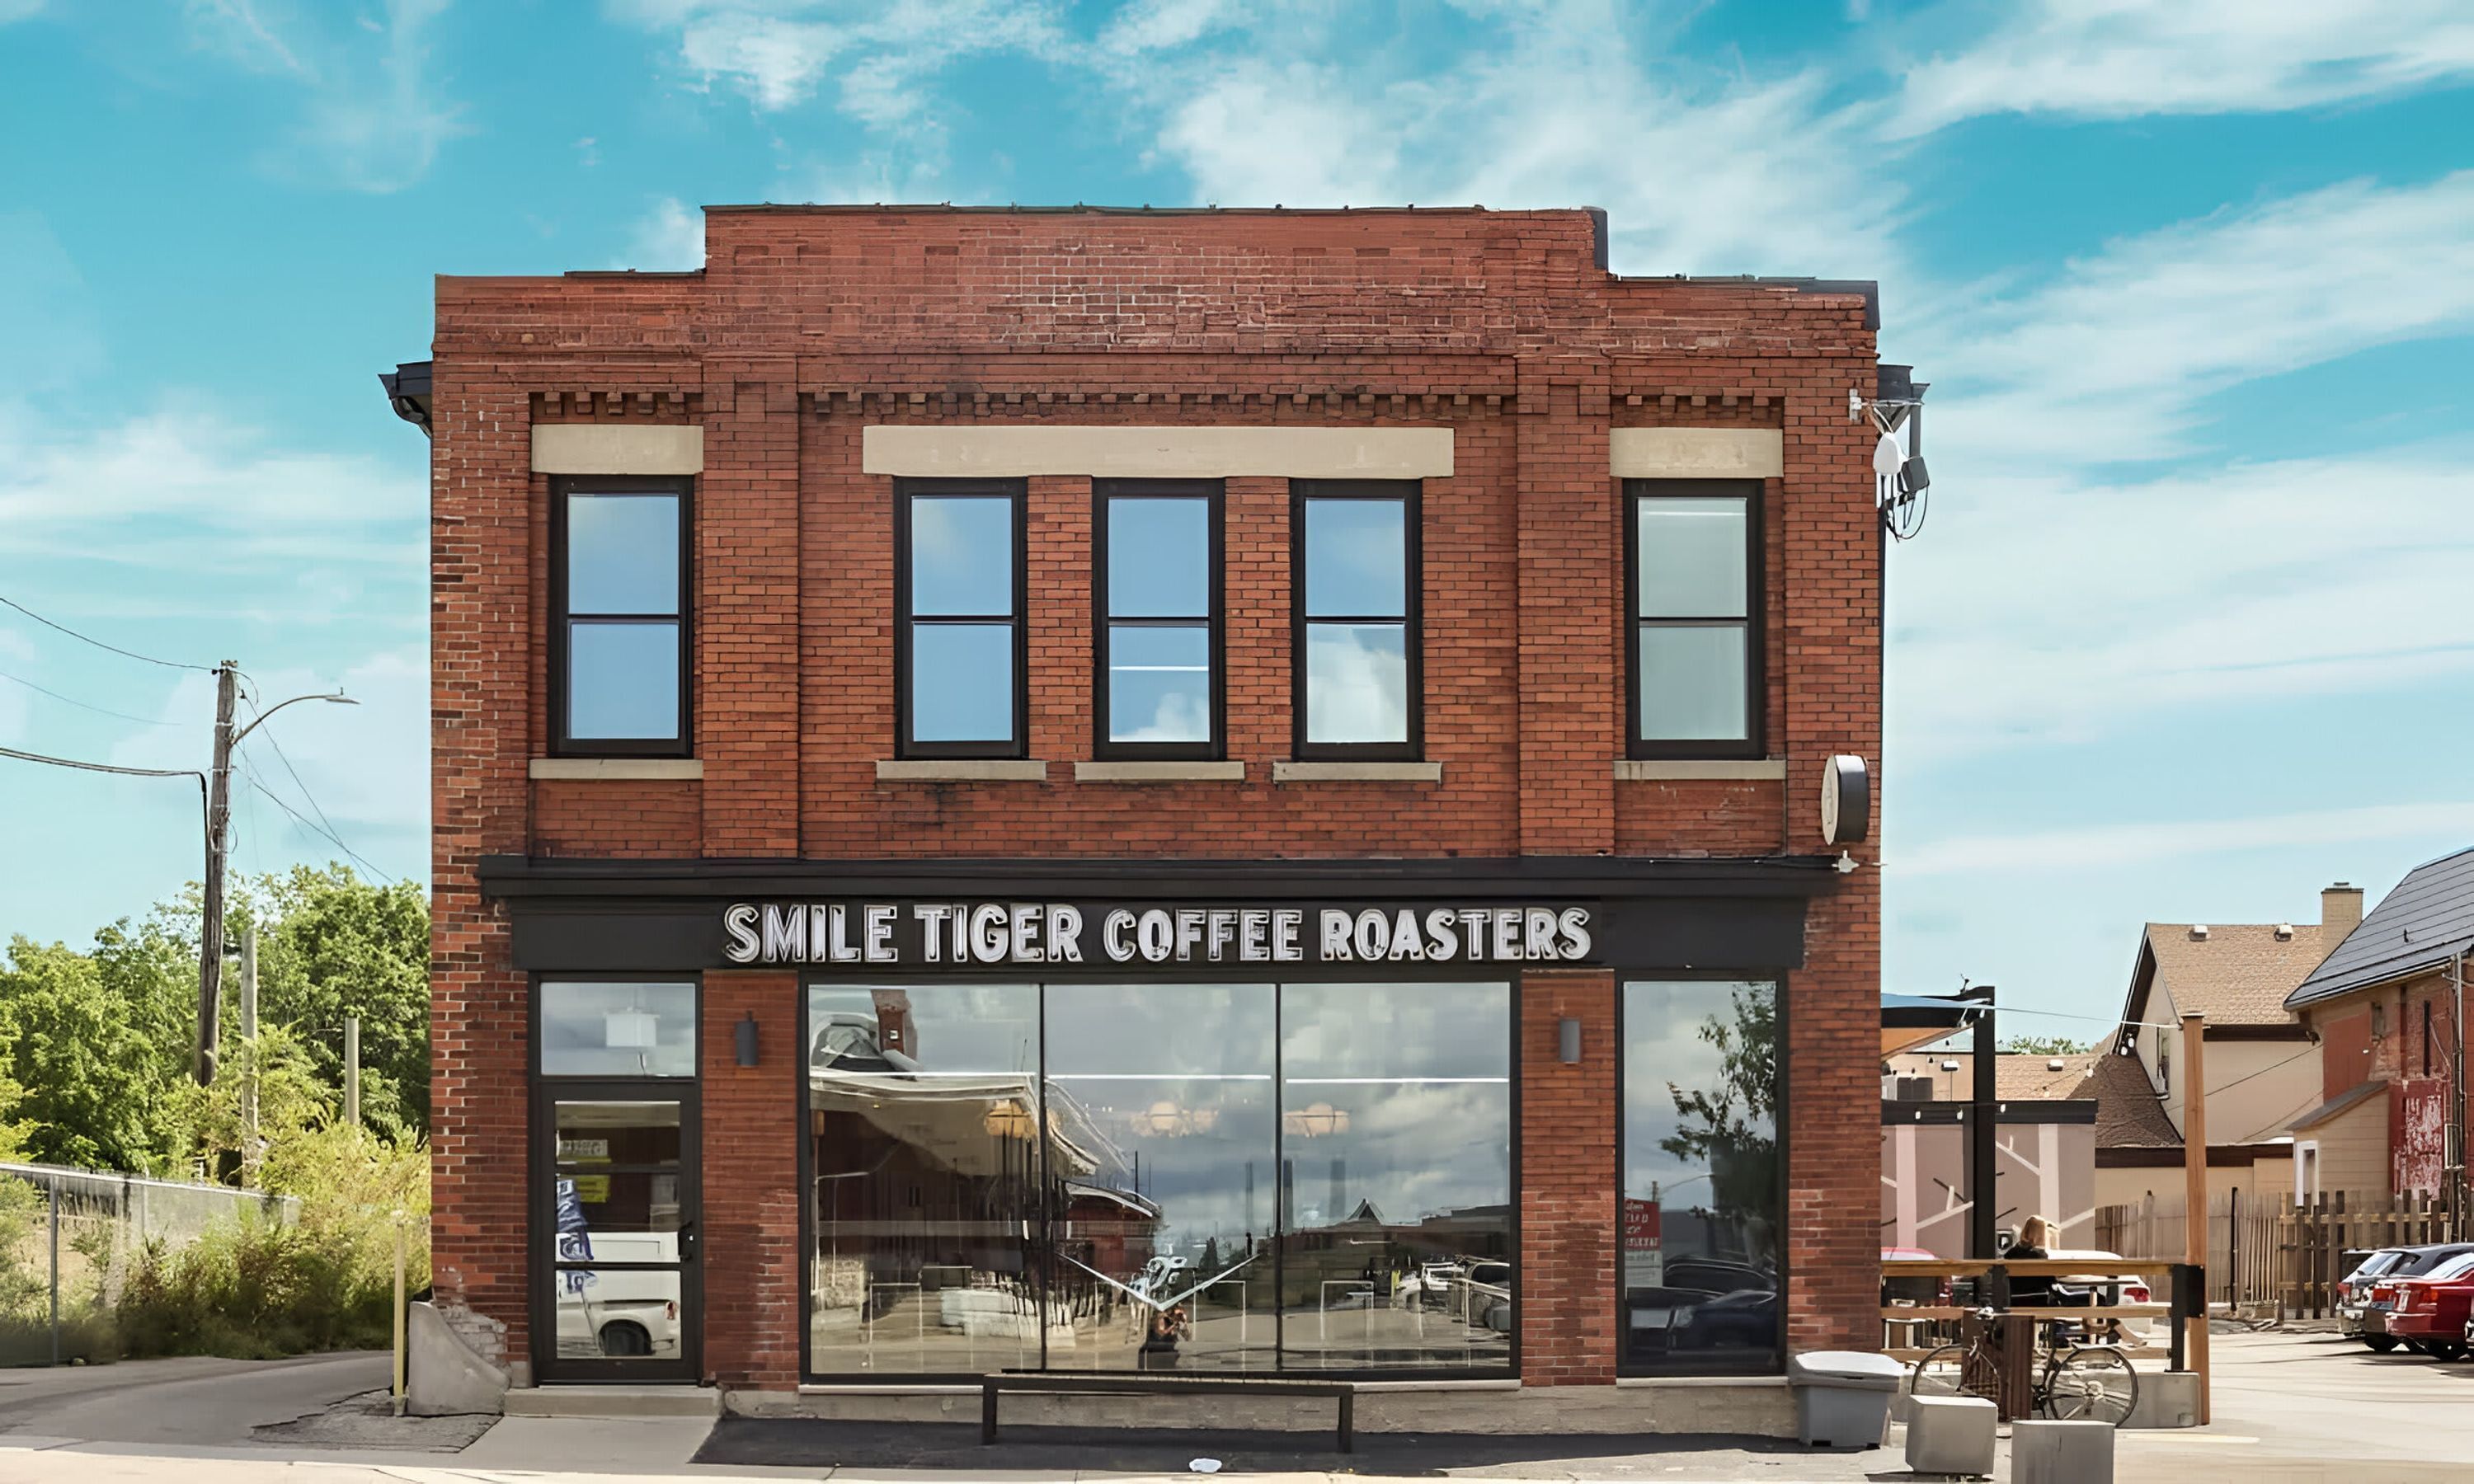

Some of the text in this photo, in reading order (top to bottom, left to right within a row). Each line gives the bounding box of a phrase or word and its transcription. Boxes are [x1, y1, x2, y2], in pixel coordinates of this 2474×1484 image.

[724, 904, 1591, 962] SMILE TIGER COFFEE ROASTERS
